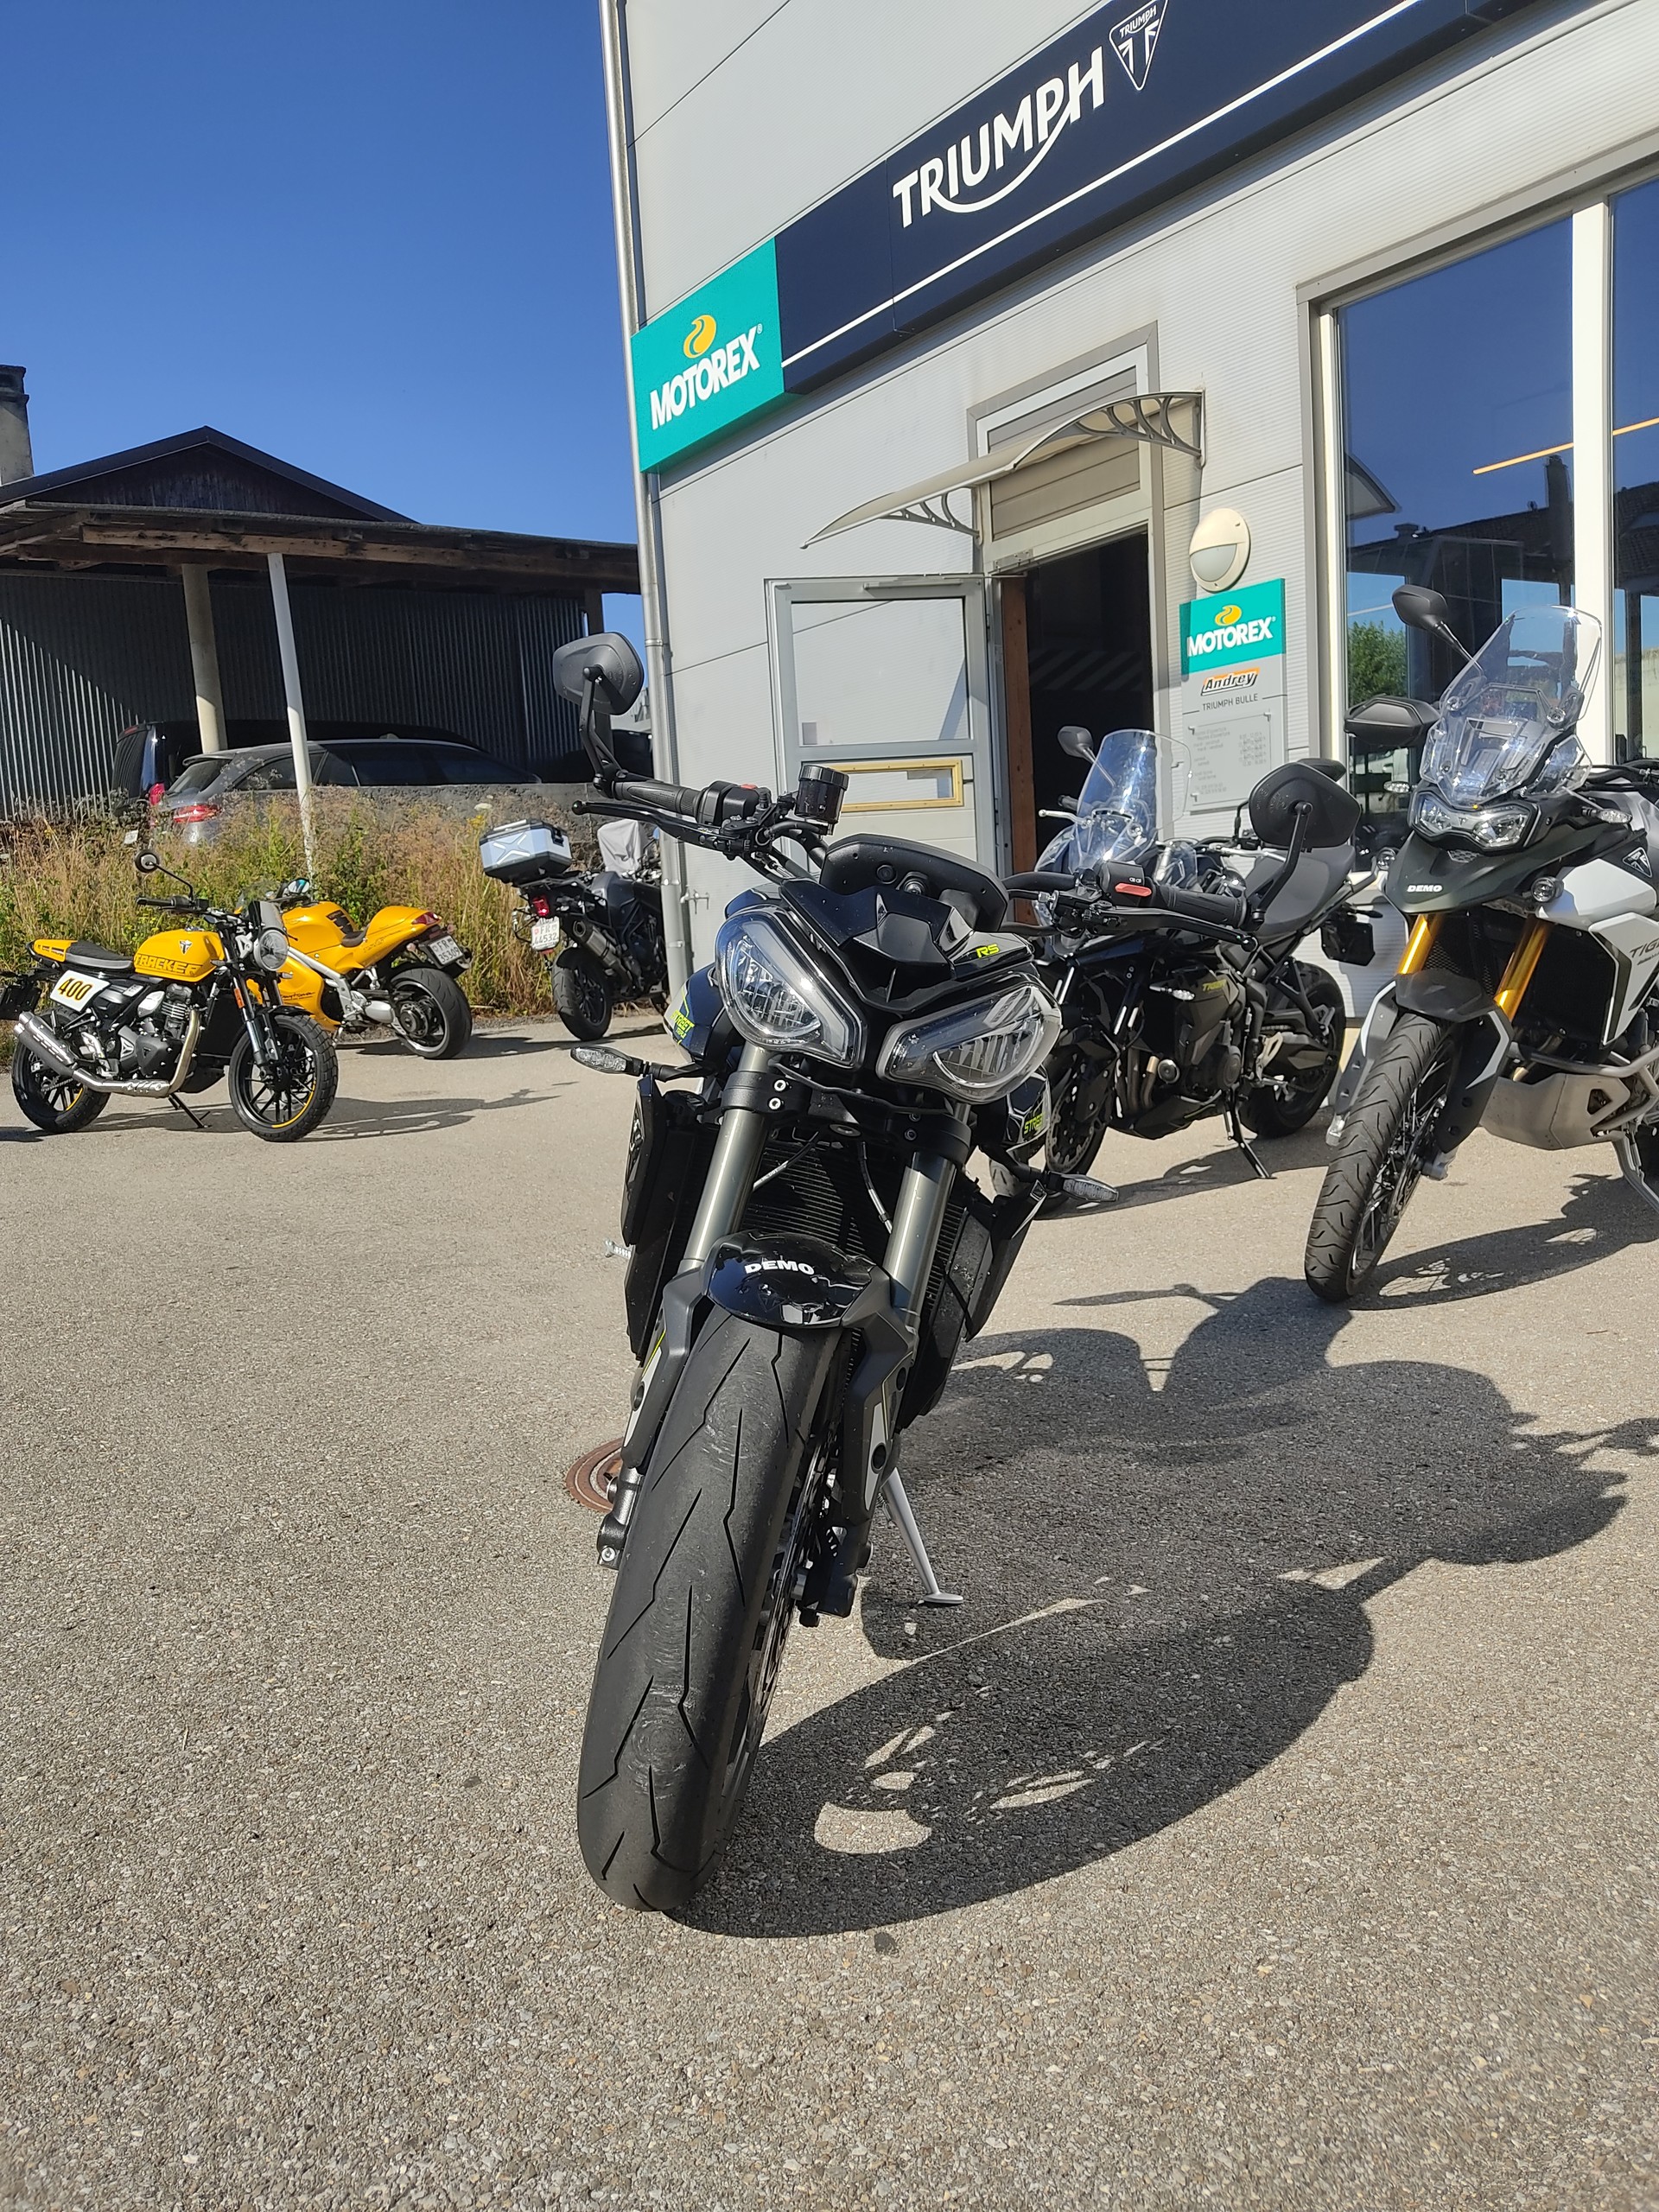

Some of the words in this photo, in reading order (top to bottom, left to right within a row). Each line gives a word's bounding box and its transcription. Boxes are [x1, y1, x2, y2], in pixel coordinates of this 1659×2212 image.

[1120, 4, 1157, 39] TRIUMPH
[892, 46, 1105, 228] TRIUMPH
[650, 325, 761, 430] MOTOREX
[1186, 616, 1274, 657] MOTOREX
[1204, 672, 1257, 691] Andrey
[1202, 697, 1234, 710] TRIUMPH
[1235, 693, 1258, 705] BULLE
[1407, 884, 1443, 893] DEMO
[540, 925, 550, 934] FR
[436, 939, 449, 950] FR
[976, 944, 1000, 958] RS
[438, 946, 461, 963] 35309
[134, 954, 201, 976] TRACKER
[57, 977, 93, 1001] 400
[745, 1260, 815, 1275] DEMO
